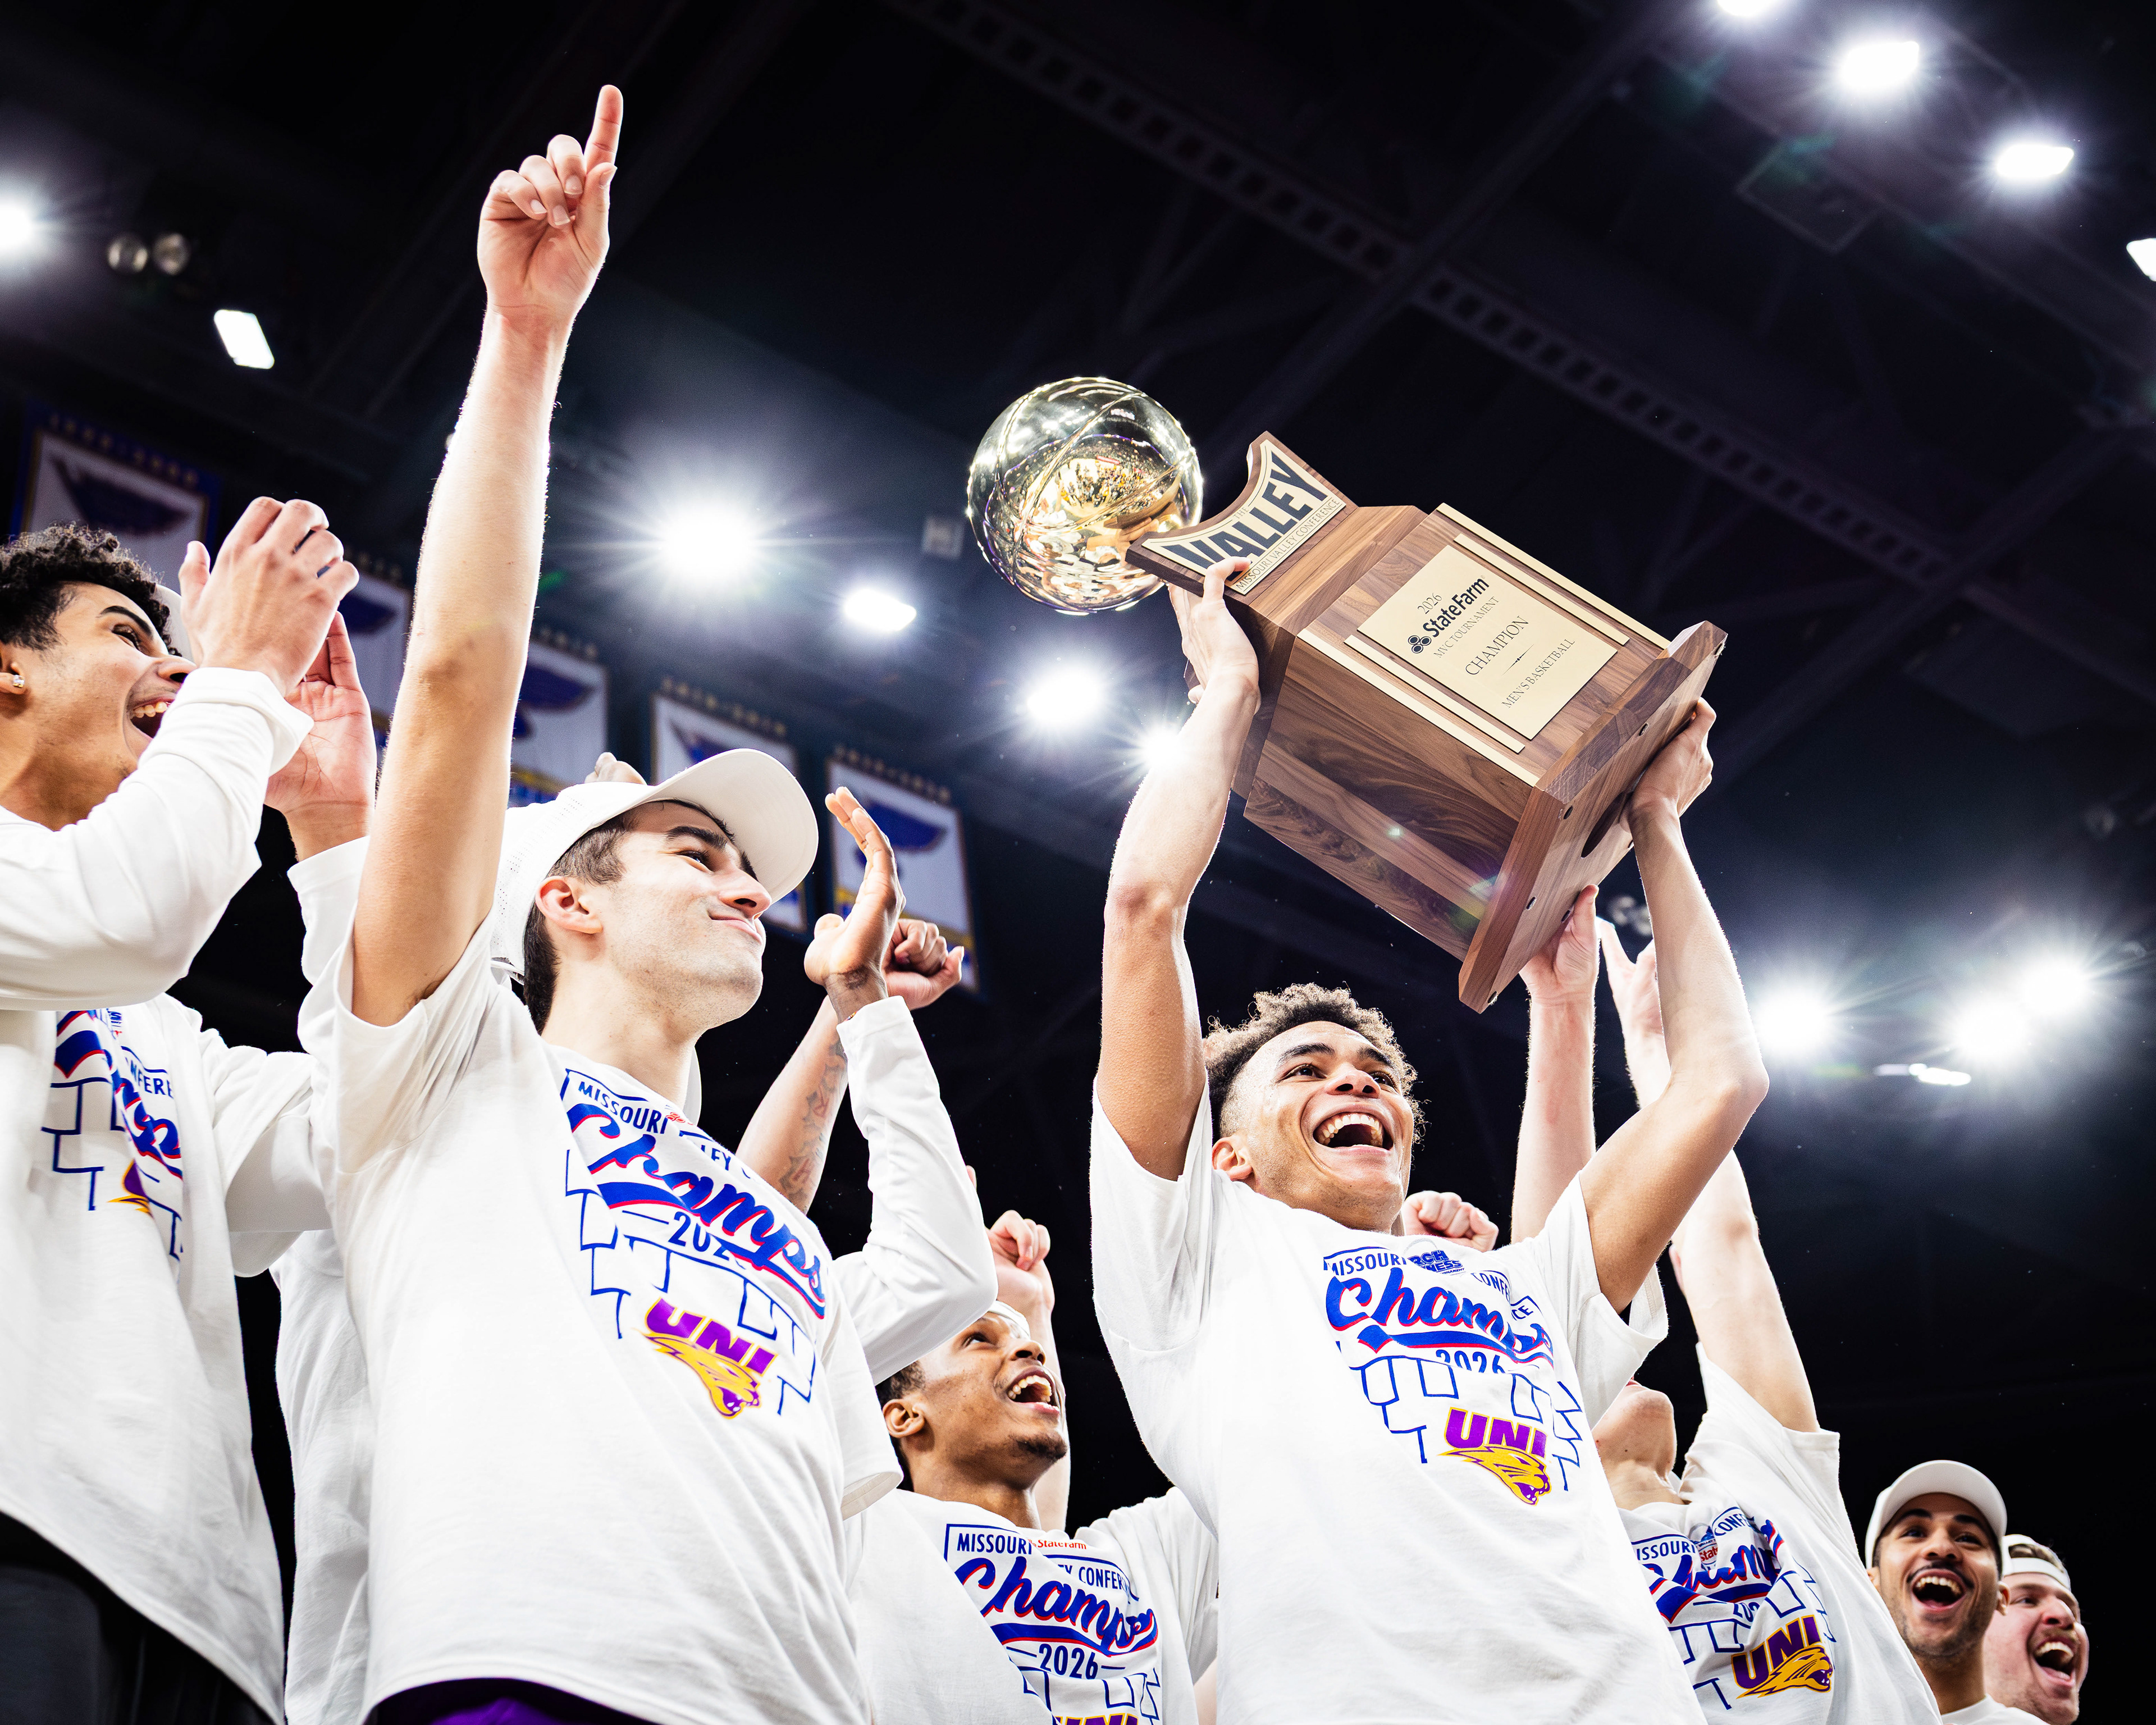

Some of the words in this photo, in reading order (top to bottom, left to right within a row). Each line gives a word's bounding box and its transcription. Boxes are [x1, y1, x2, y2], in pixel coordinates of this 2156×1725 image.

[1160, 450, 1329, 582] VALLEY
[1233, 506, 1250, 519] THE
[1236, 556, 1272, 591] MISSOURI
[1269, 535, 1298, 564] VALLEY
[1296, 498, 1340, 537] CONFERENCE
[1417, 592, 1442, 614] 2026
[1433, 640, 1454, 659] MVC
[1451, 596, 1500, 642] TOURNAMENT
[1465, 615, 1529, 676] CHAMPION
[1501, 681, 1531, 709] MEN'S
[1524, 638, 1575, 685] BASKETBALL
[578, 1081, 668, 1134] MISSOURI
[645, 1298, 778, 1376] UNI
[1443, 1406, 1548, 1459] UNI
[957, 1532, 1032, 1554] MISSOURI
[1038, 1643, 1099, 1680] 2026
[1731, 1614, 1821, 1690] UNI
